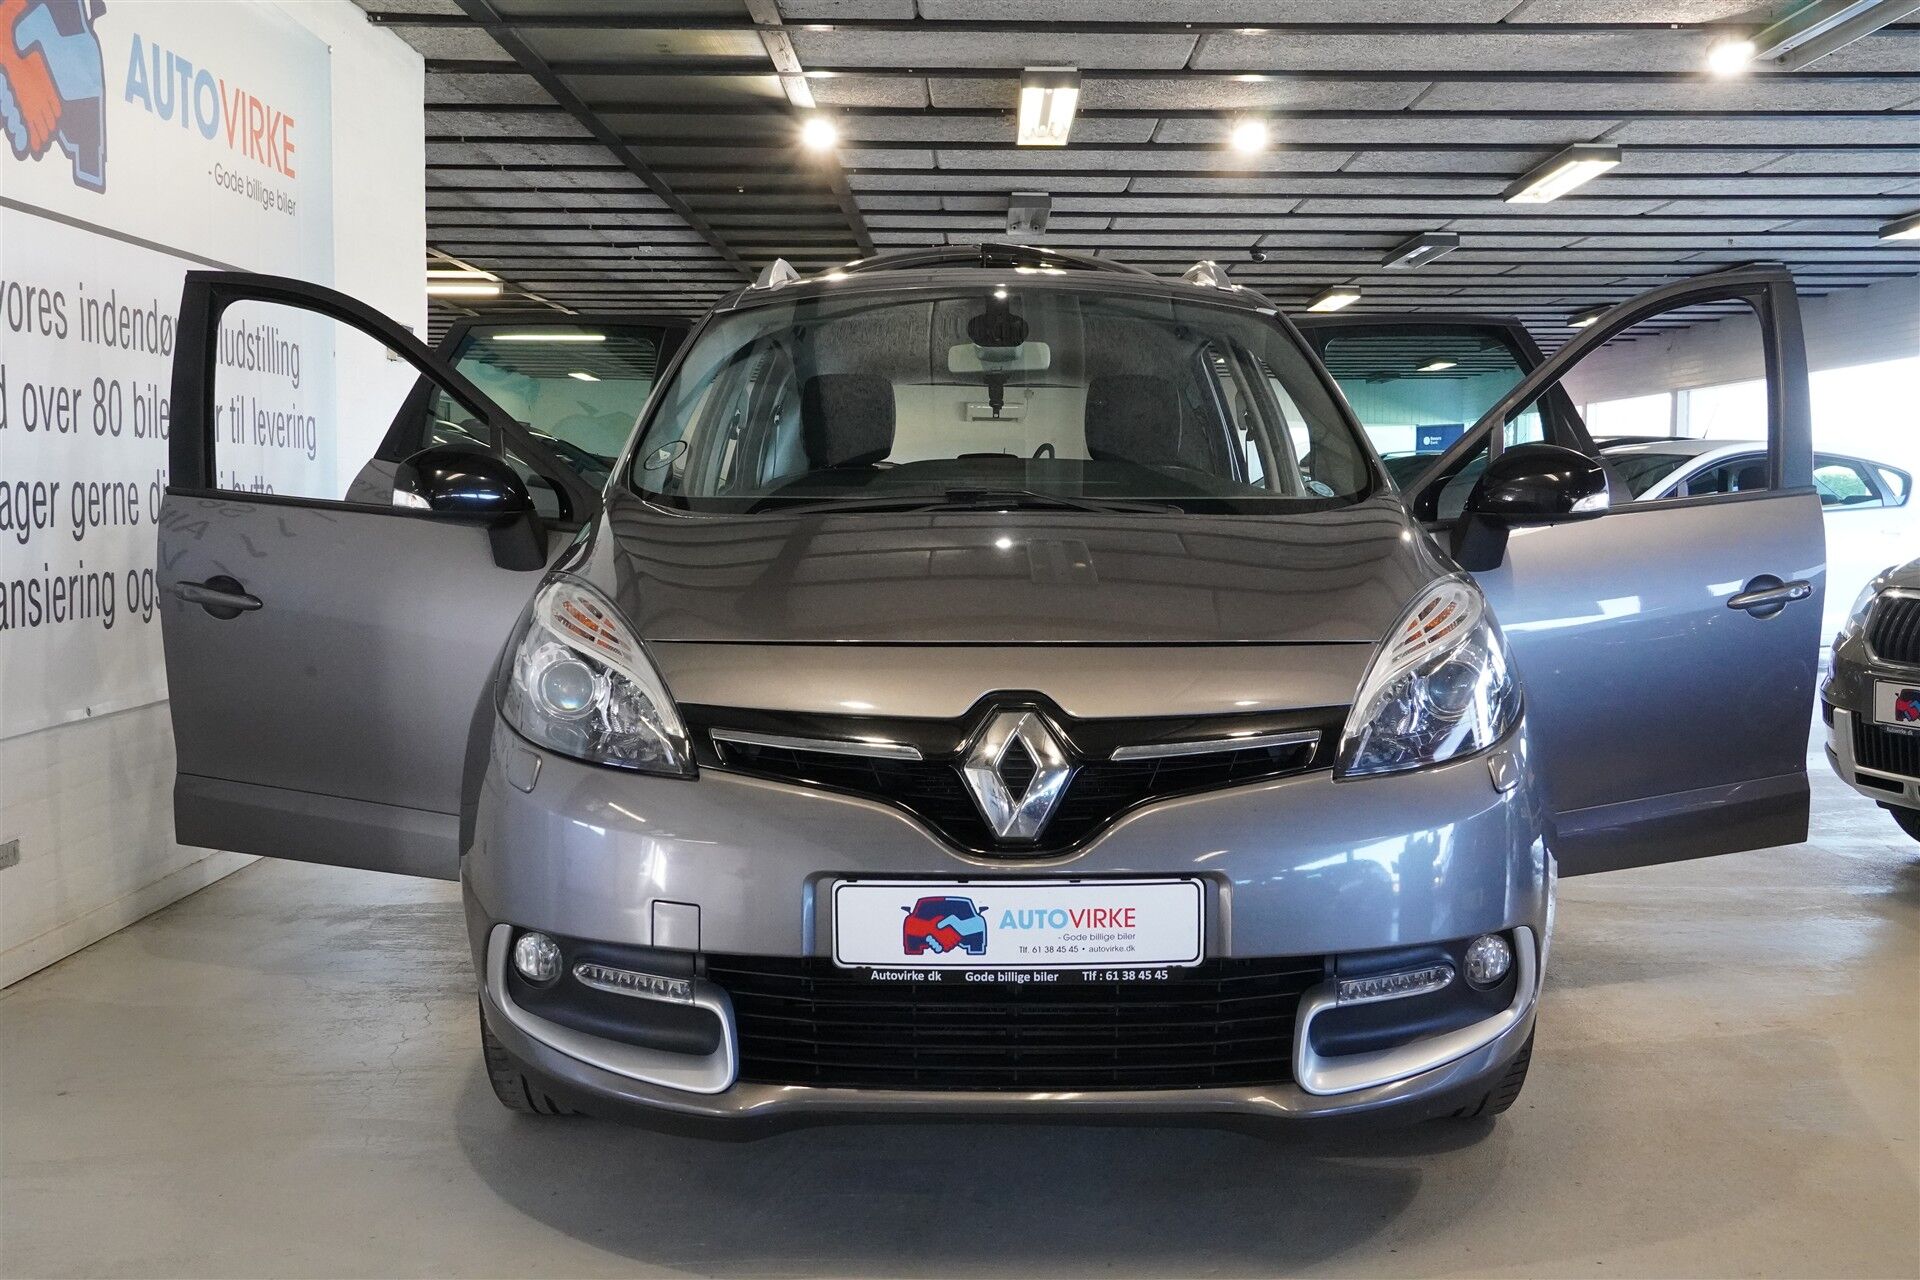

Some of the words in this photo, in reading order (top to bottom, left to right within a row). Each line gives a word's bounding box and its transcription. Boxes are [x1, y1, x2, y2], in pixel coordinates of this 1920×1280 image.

[125, 32, 296, 179] AUTOVIRKE
[214, 162, 244, 195] Gode
[246, 175, 275, 211] billige
[276, 188, 296, 216] biler
[219, 317, 300, 389] ludstilling
[22, 382, 82, 434] over
[93, 376, 123, 438] 80
[132, 381, 170, 440] bile
[229, 395, 245, 444] til
[252, 396, 317, 461] levering
[71, 481, 139, 542] gerne
[126, 567, 161, 624] og
[999, 908, 1136, 929] AUTOVIRKE
[1063, 933, 1087, 941] Gode
[1089, 933, 1116, 942] billige
[1117, 932, 1136, 940] biler
[1031, 945, 1042, 953] 61
[1044, 945, 1055, 953] 38
[1056, 945, 1067, 953] 45
[1068, 945, 1079, 953] 45
[1088, 944, 1136, 953] autovirke.dk
[870, 970, 925, 981] Autovirke
[927, 970, 942, 981] dk
[965, 971, 995, 982] Gode
[997, 971, 1031, 984] billige
[1033, 971, 1059, 982] biler
[1105, 970, 1120, 981] 61
[1121, 970, 1136, 981] 38
[1138, 970, 1152, 980] 45
[1154, 970, 1169, 980] 45
